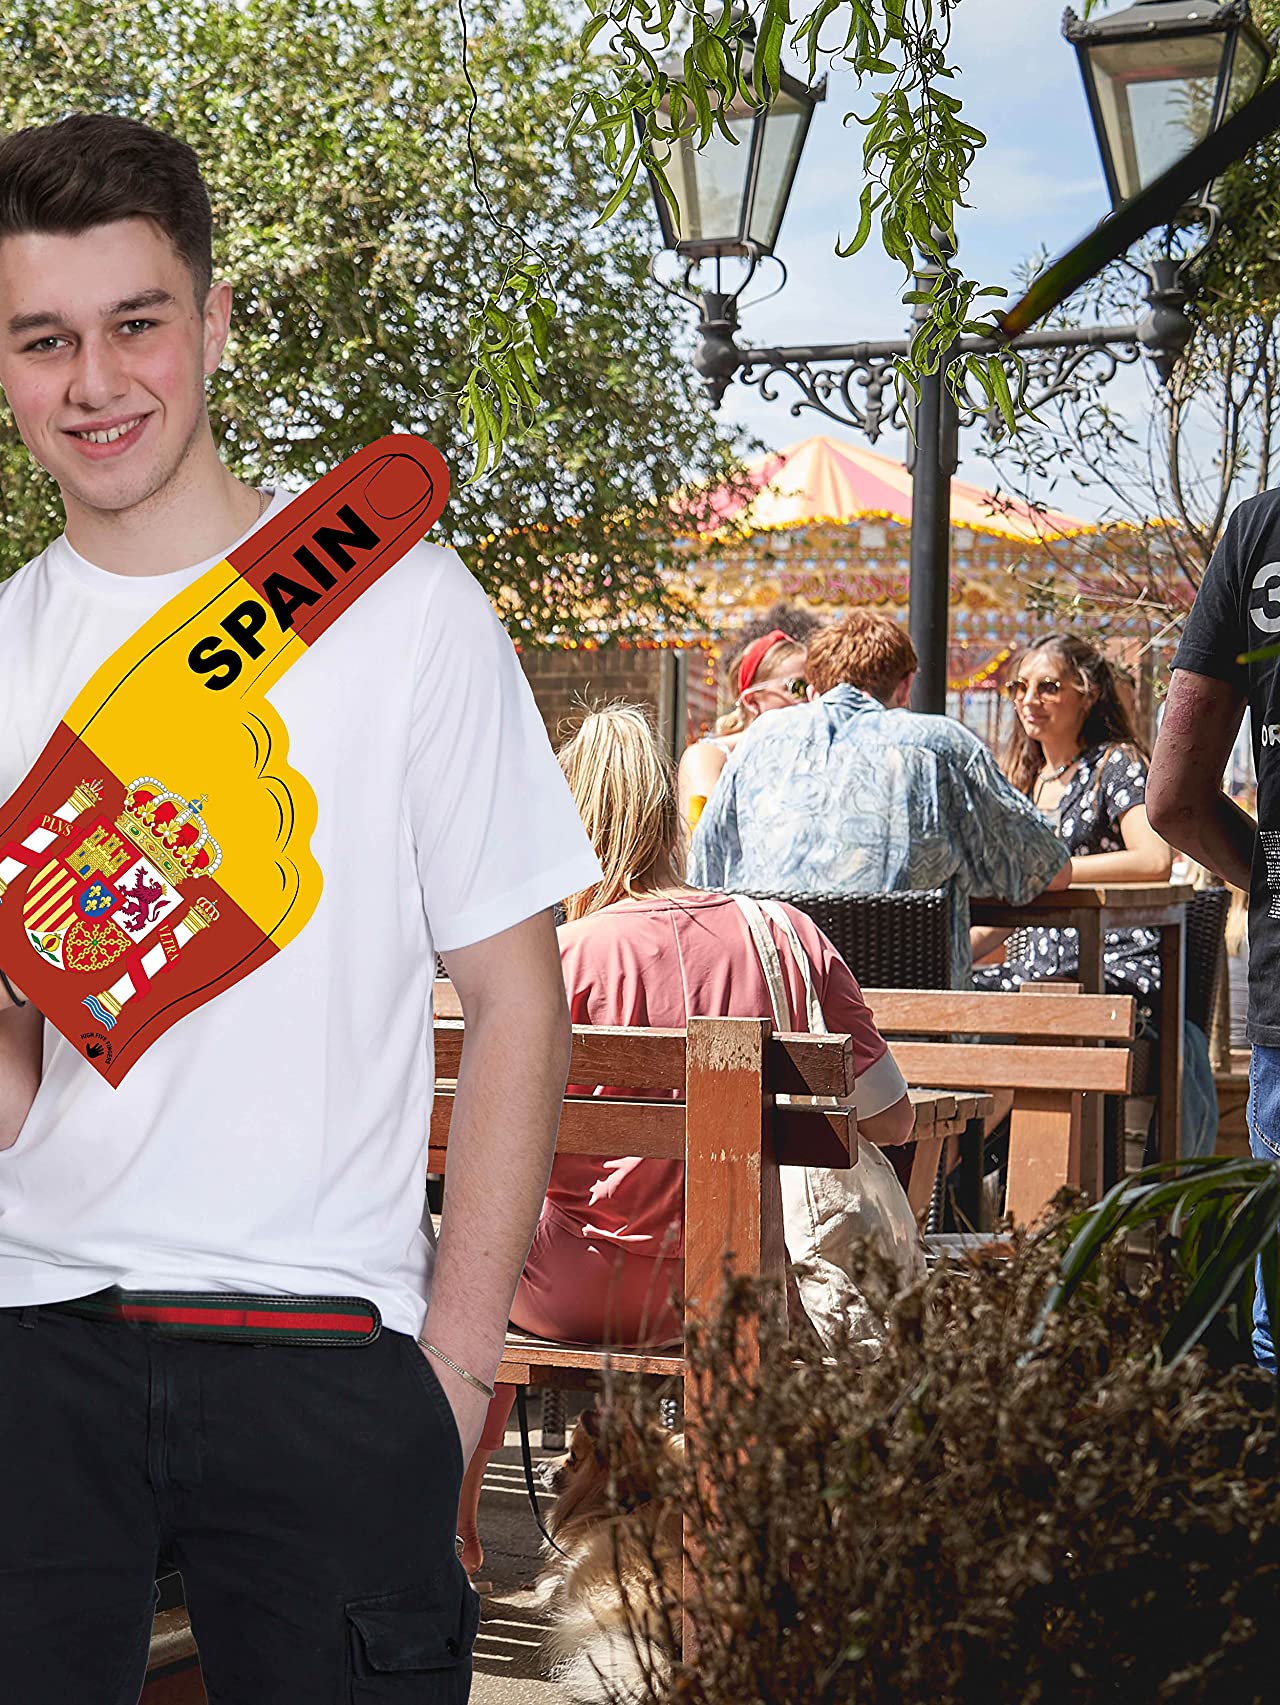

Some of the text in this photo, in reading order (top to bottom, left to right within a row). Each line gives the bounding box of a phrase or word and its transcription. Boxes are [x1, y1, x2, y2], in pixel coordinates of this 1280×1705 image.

[188, 503, 381, 691] SPAIN
[41, 815, 74, 837] PLVS
[159, 924, 180, 962] VLTRA
[95, 1032, 107, 1042] FIVE
[104, 1041, 113, 1064] FINGERS
